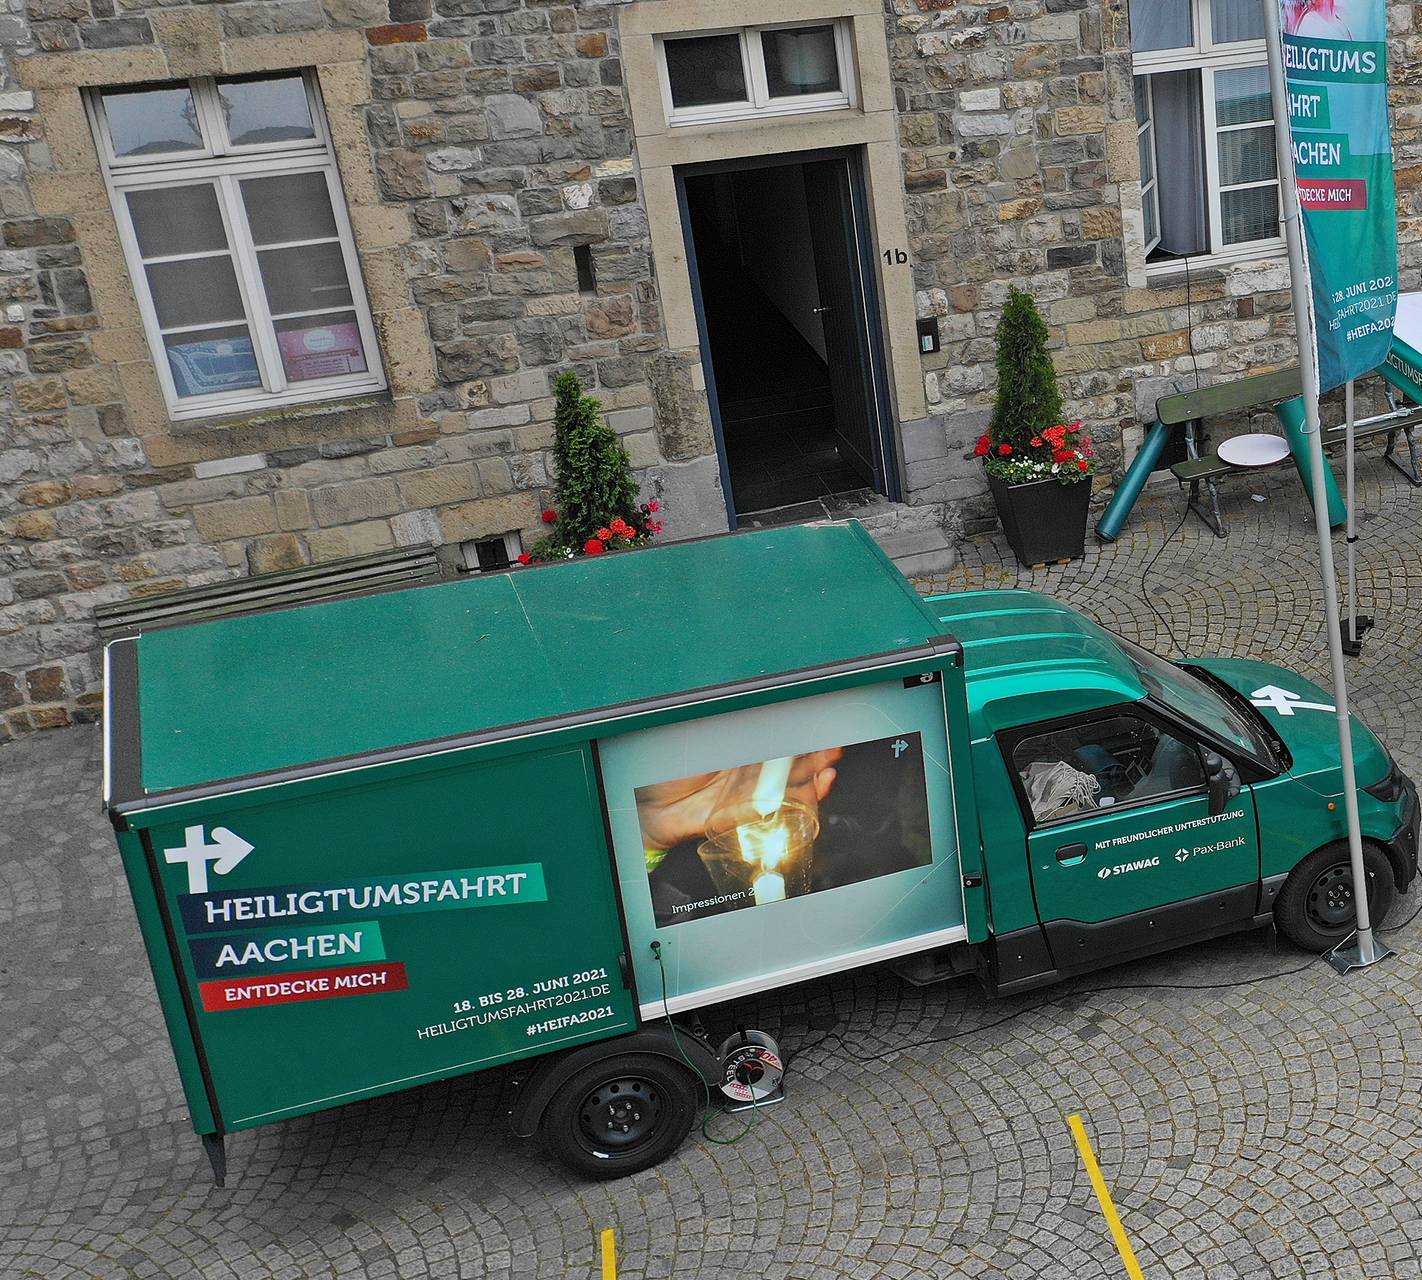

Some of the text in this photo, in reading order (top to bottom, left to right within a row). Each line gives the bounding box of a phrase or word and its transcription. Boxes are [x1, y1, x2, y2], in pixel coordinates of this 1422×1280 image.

[1284, 44, 1376, 74] EILIGTUMS
[1292, 141, 1341, 165] ACHEN
[1327, 188, 1352, 202] MICH
[883, 248, 908, 266] 1b
[1346, 281, 1367, 298] JUNI
[1369, 275, 1394, 291] 202
[1346, 316, 1395, 342] #HEIFA202
[1095, 839, 1111, 850] MIT
[1112, 825, 1174, 847] FREUNDLICHER
[1193, 836, 1246, 856] Pax-Bank
[1112, 856, 1160, 876] STAWAG
[204, 872, 527, 924] HEILIGTUMSFAHRT
[671, 890, 745, 914] Impressionen
[215, 931, 362, 968] AACHEN
[224, 971, 387, 1002] ENTDECKE MICH
[453, 967, 608, 1014] 18. BIS 28. JUNI 2021
[416, 983, 611, 1039] HEILIGTUMSFAHRT2021.DE
[526, 1006, 615, 1037] #HEIFA2021
